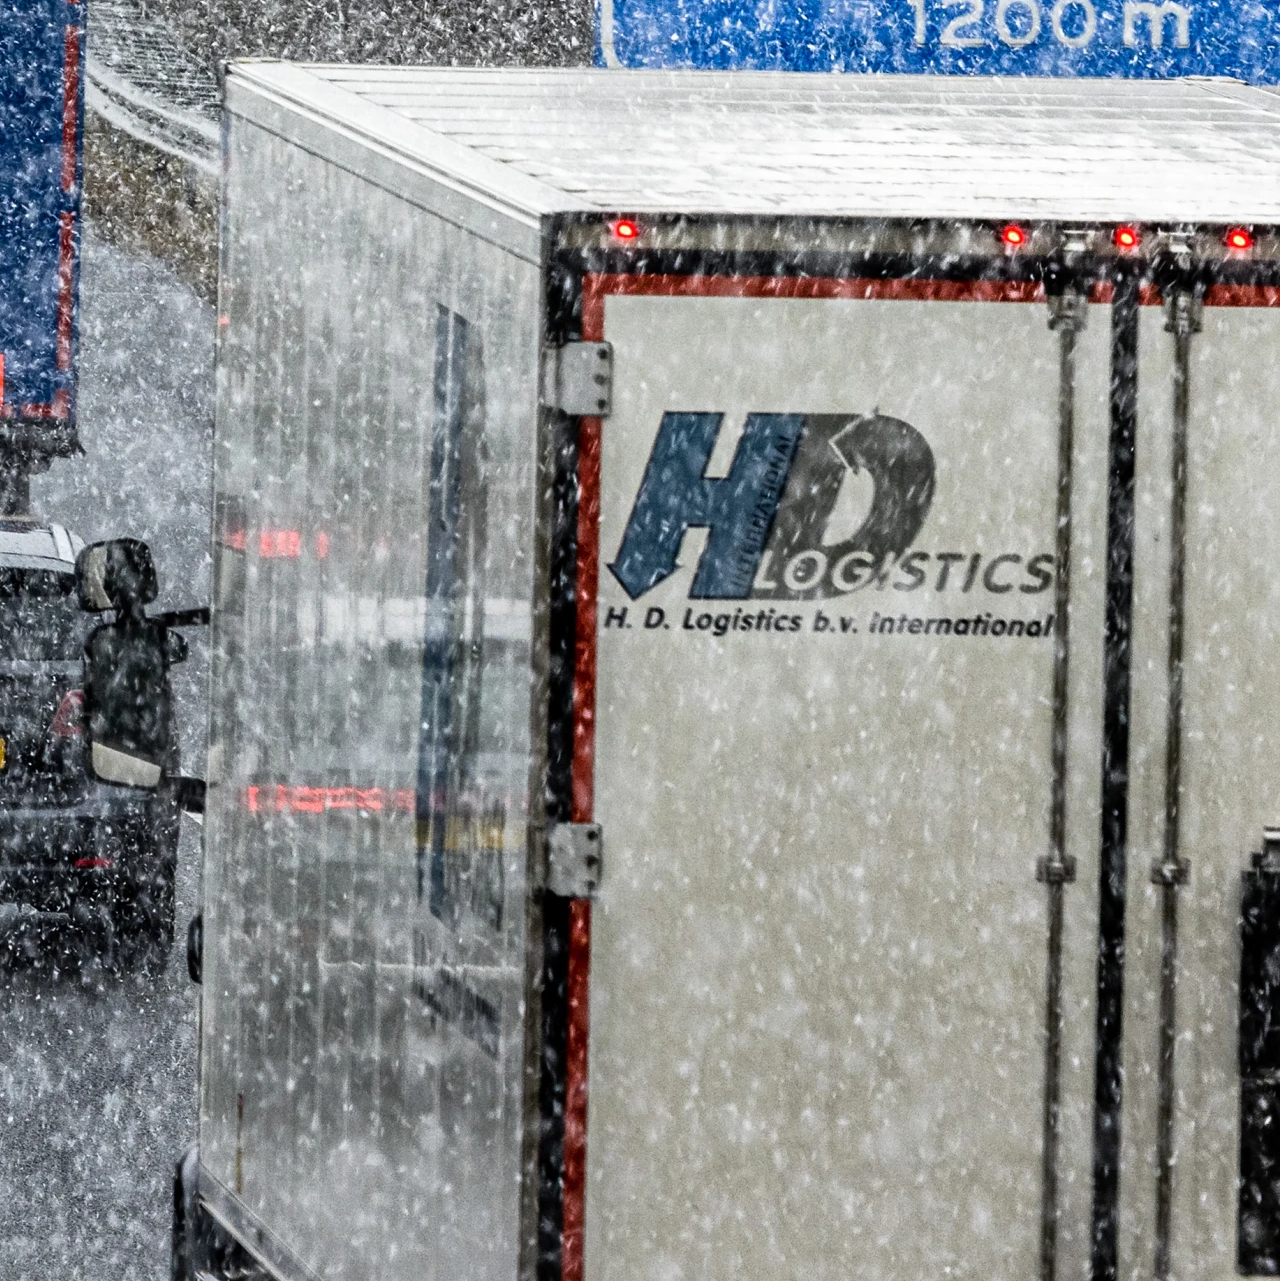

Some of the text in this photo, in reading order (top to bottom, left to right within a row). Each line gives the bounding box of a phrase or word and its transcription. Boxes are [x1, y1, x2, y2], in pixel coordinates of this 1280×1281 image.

[754, 550, 1056, 596] LOGISTICS
[604, 606, 1055, 639] H. D. Logistics b.v. International
